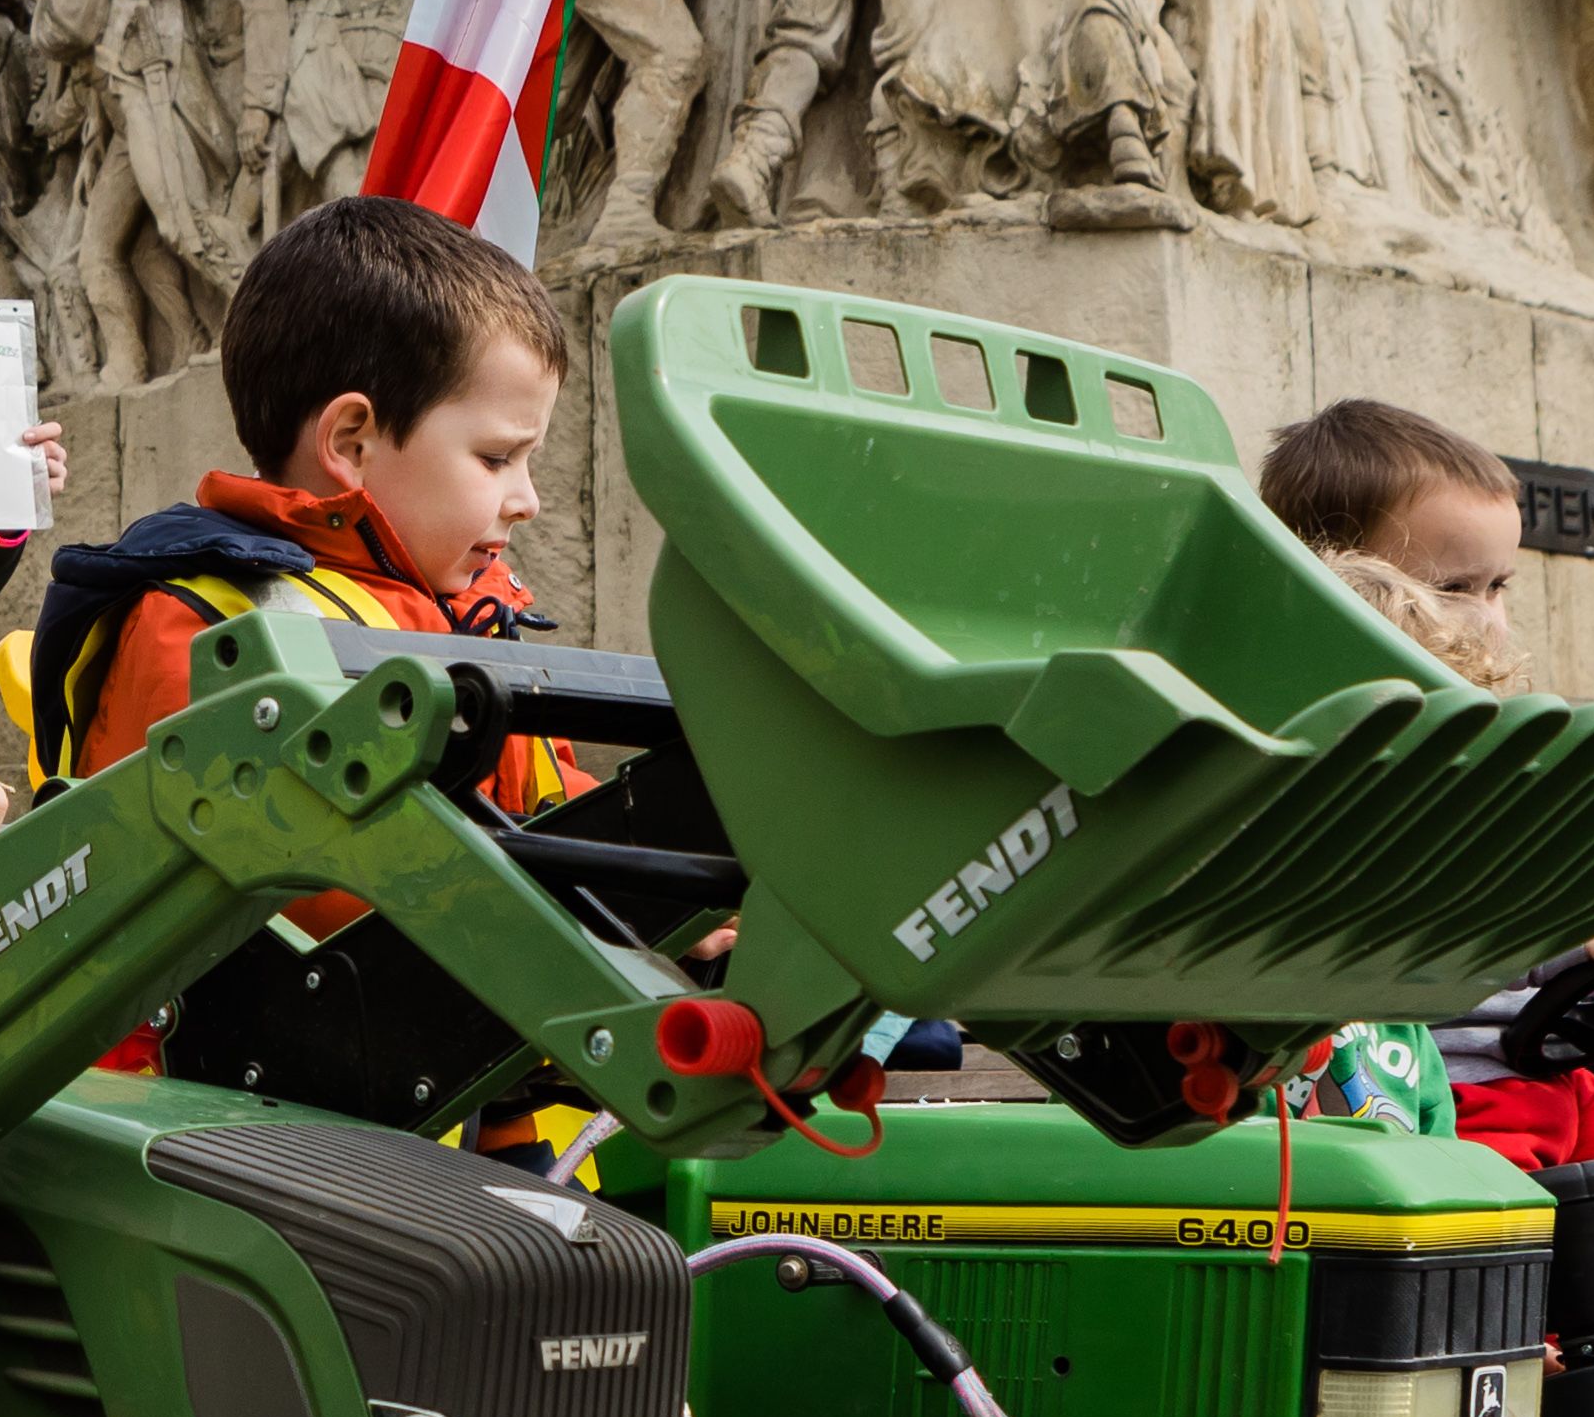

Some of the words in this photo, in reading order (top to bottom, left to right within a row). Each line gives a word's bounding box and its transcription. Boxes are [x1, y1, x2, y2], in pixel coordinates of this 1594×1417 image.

[892, 782, 1079, 963] FENDT
[730, 1209, 821, 1237] JOHN
[831, 1212, 945, 1240] DEERE
[1177, 1217, 1311, 1249] 6400
[540, 1334, 649, 1371] FENDT
